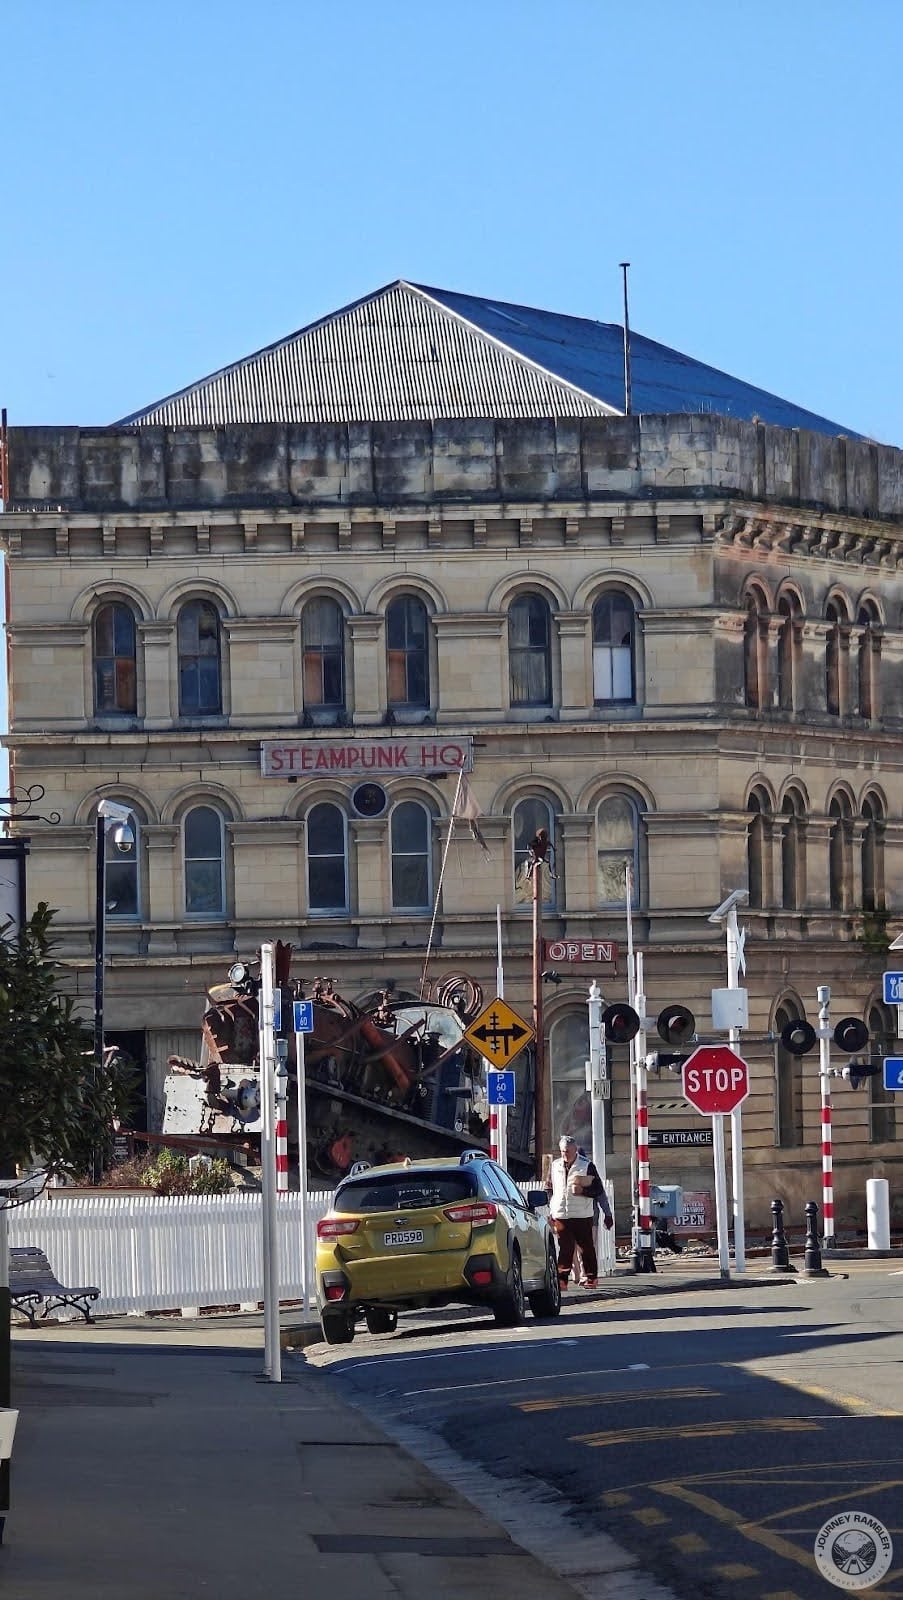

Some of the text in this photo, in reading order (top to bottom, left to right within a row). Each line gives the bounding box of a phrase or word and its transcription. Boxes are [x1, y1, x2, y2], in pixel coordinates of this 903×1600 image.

[271, 745, 464, 770] STEAMPUNK HQ
[549, 943, 612, 961] OPEN
[299, 1004, 306, 1016] P
[300, 1016, 308, 1026] 60
[497, 1074, 505, 1082] P
[688, 1068, 744, 1093] STOP
[496, 1082, 507, 1092] 60
[662, 1132, 712, 1144] ENTRANCE
[673, 1214, 705, 1226] OPEN
